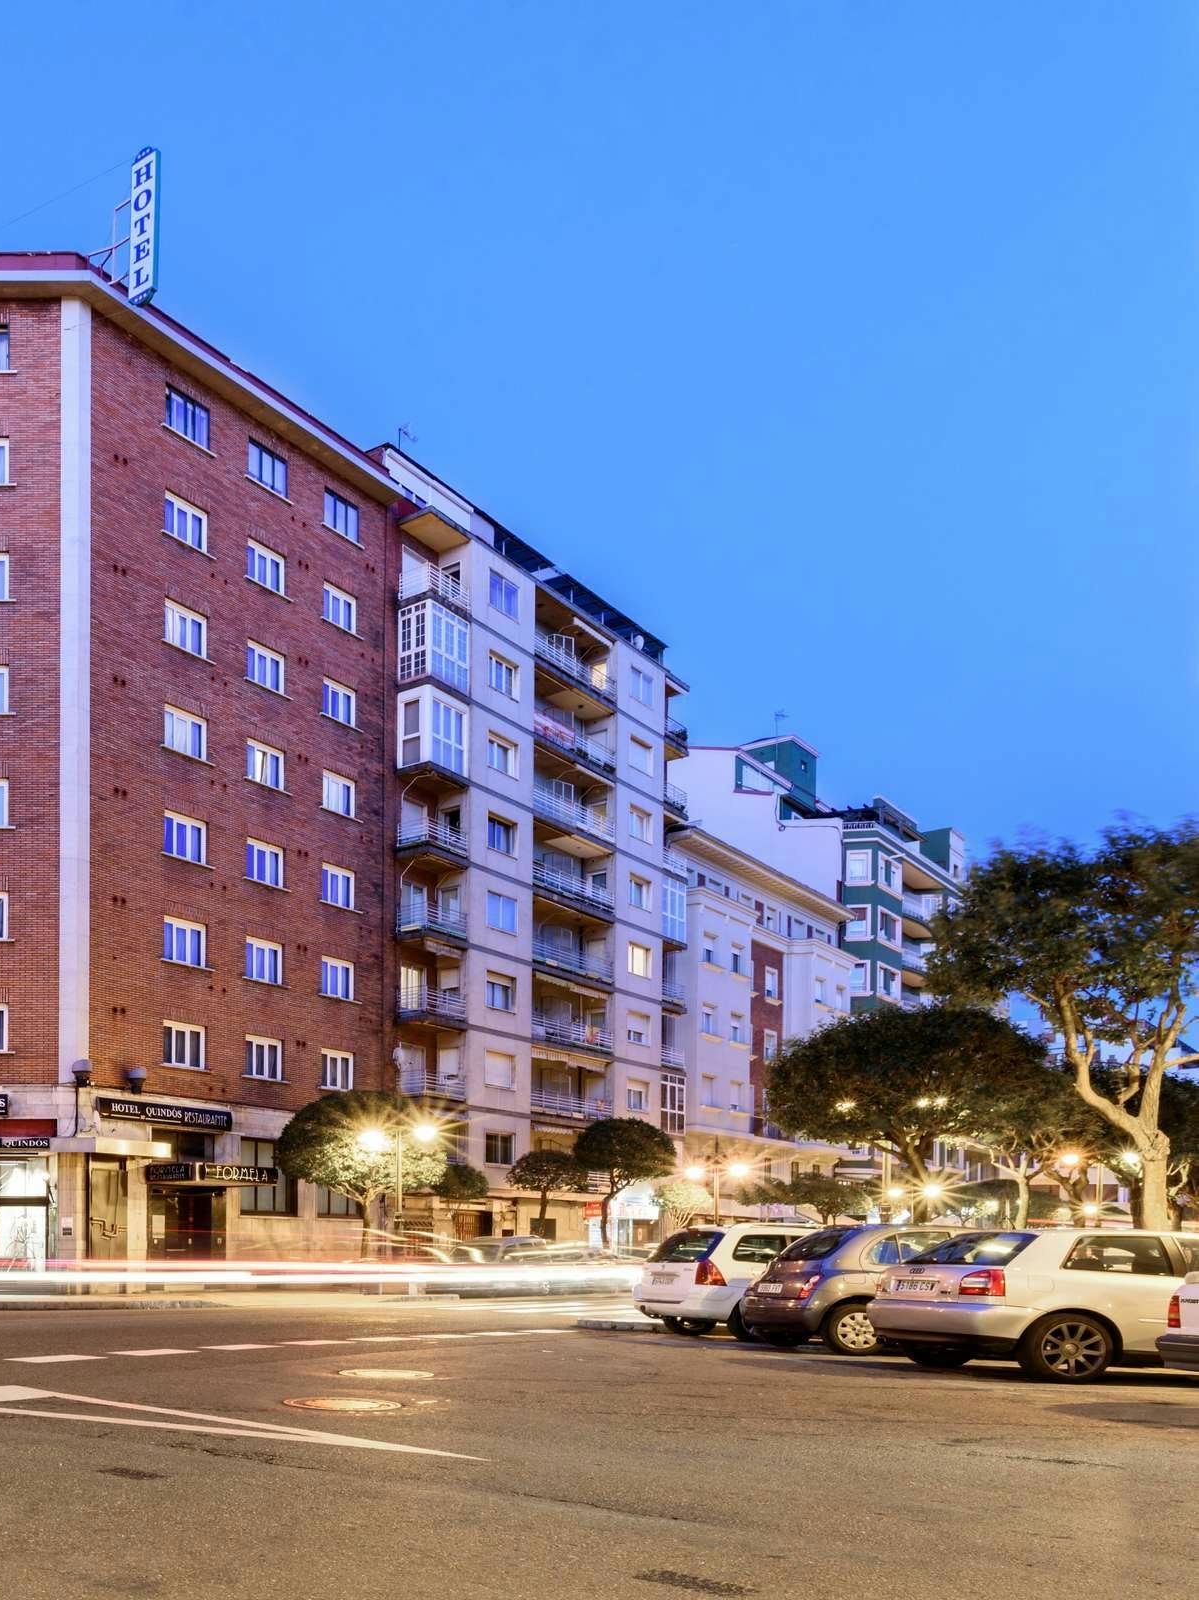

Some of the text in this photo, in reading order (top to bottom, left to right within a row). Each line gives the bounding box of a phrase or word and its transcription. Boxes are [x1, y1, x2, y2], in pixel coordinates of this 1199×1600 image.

[133, 160, 153, 290] HOTEL
[110, 1102, 140, 1114] HOTEL
[145, 1105, 182, 1119] QUINDÓS
[216, 1165, 268, 1183] FORMELA
